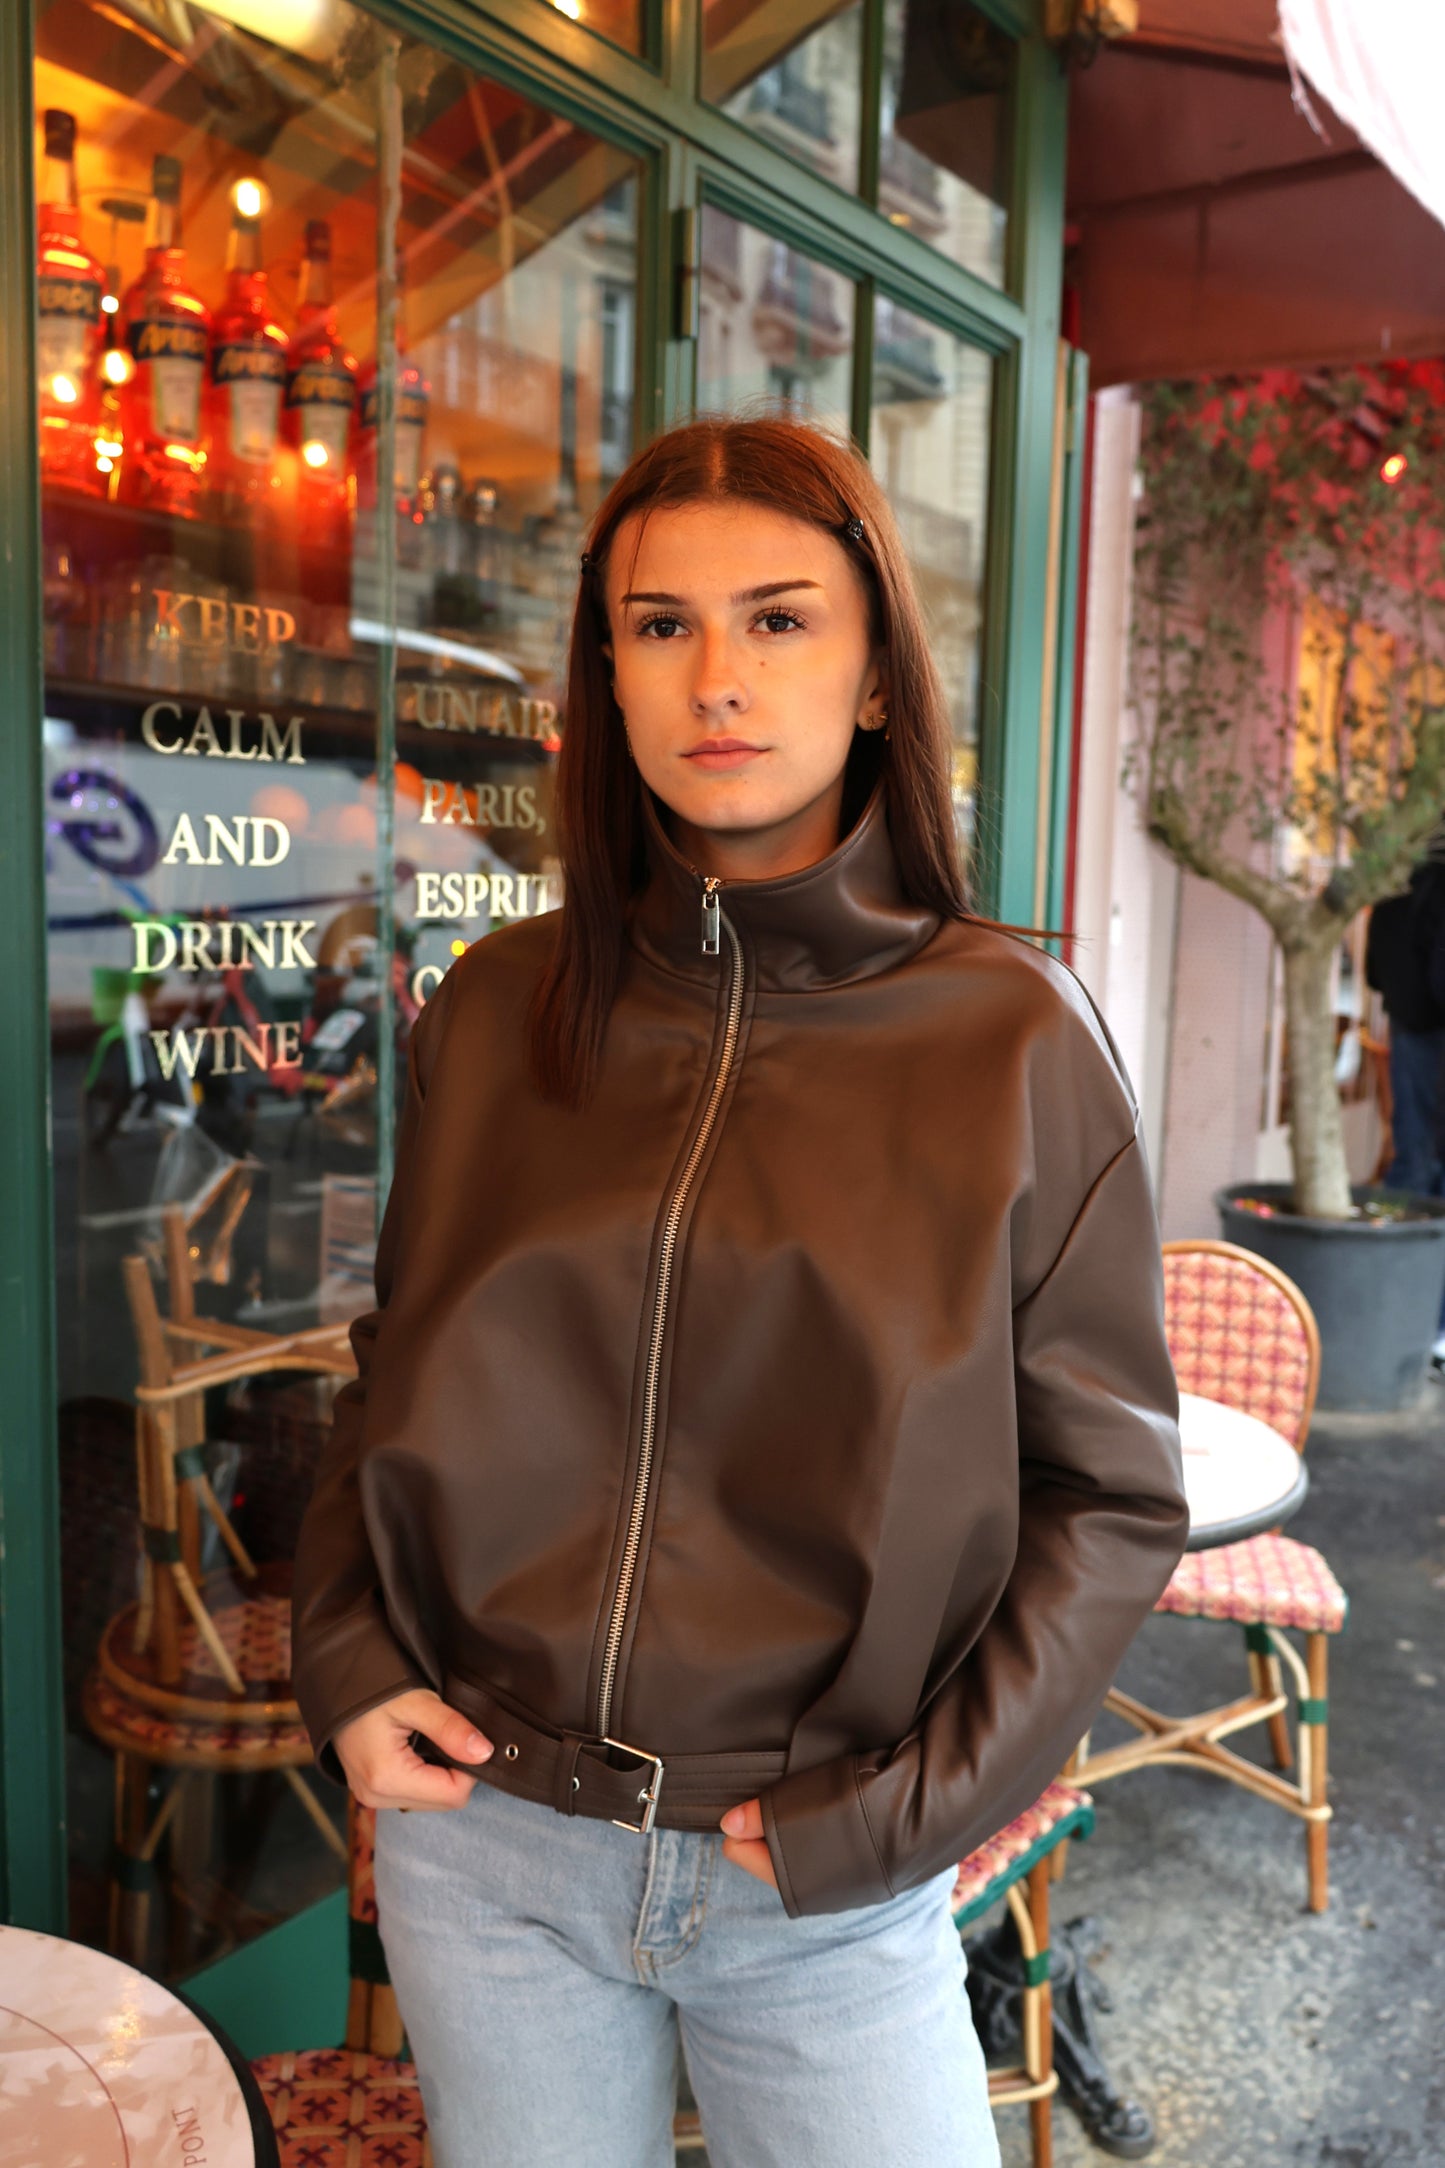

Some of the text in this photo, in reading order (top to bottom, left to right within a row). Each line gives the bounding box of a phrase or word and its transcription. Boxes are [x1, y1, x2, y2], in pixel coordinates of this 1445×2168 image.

[152, 588, 297, 658] KEEP
[141, 701, 307, 765] CALM
[415, 682, 562, 742] UN AIR
[418, 777, 547, 836] PARIS,
[161, 812, 291, 867] AND
[415, 872, 553, 919] ESPRIT
[130, 919, 319, 974] DRINK
[149, 1021, 305, 1082] WINE
